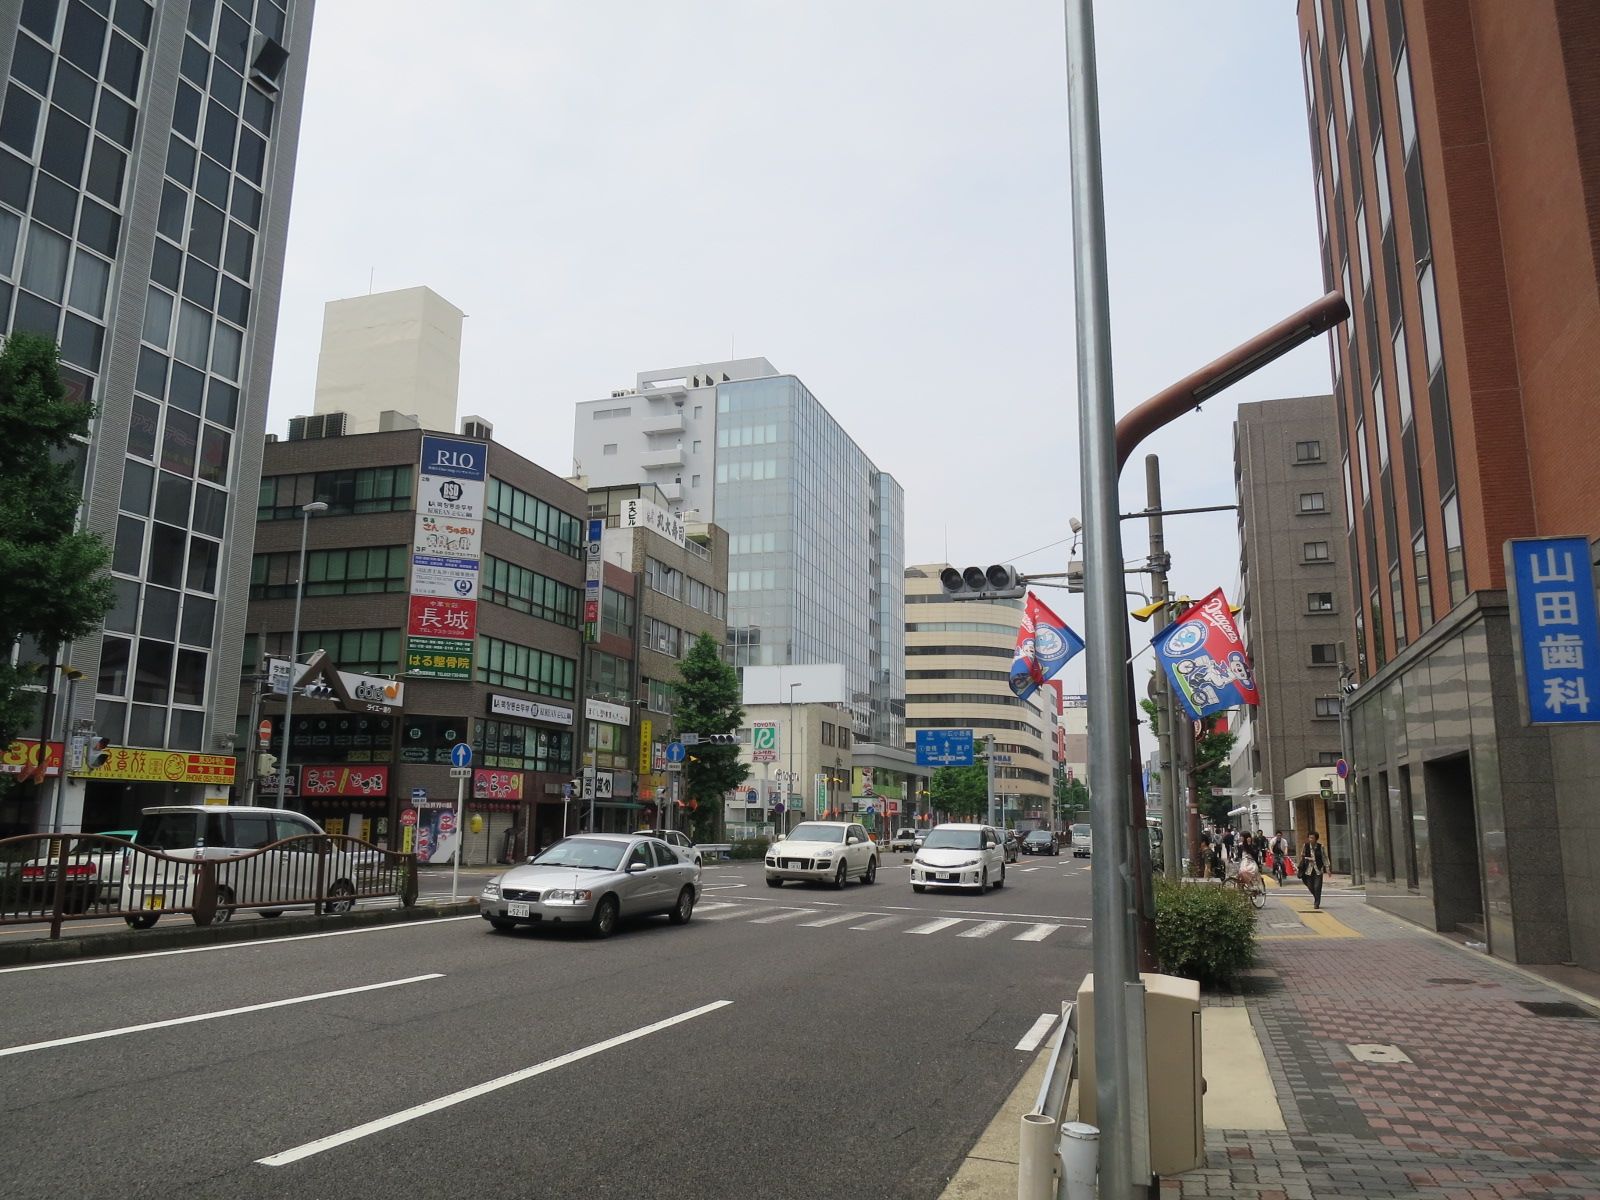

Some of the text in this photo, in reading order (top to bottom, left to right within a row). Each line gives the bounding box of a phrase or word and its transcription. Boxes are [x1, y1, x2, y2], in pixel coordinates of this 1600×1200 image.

[437, 450, 474, 468] RIO
[628, 501, 638, 526] 丸大ビル
[418, 608, 469, 630] 長城
[1202, 598, 1239, 644] Dragons
[1530, 548, 1590, 714] 山田歯科
[409, 655, 470, 669] はる整骨院
